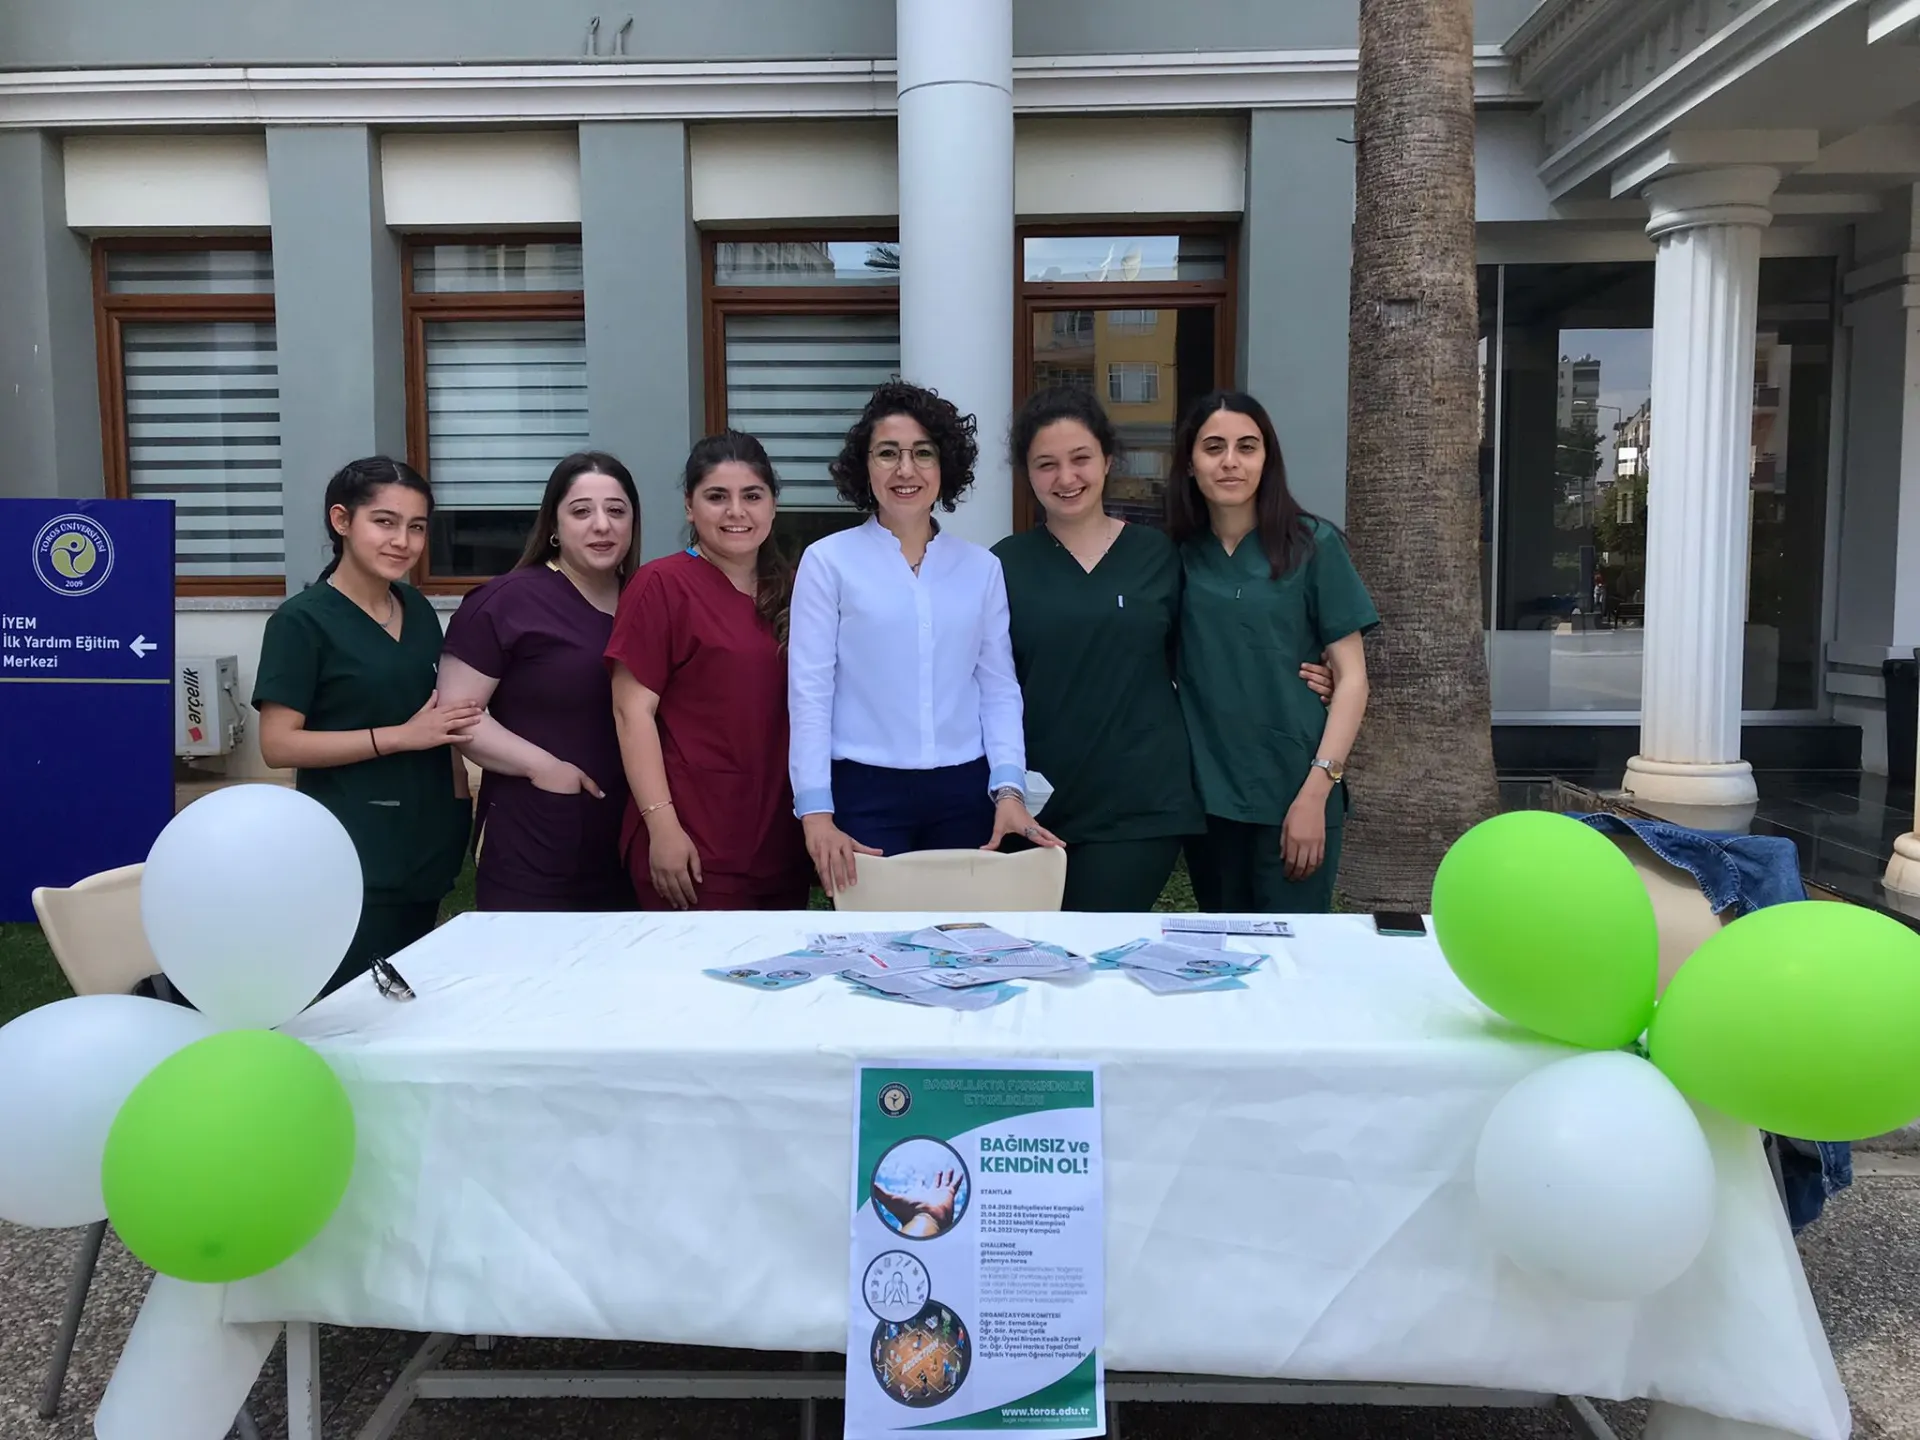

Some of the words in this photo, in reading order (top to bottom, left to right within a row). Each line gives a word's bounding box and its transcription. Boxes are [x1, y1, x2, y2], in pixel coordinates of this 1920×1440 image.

[40, 527, 60, 552] TOROS
[2, 614, 36, 629] İYEM
[3, 633, 20, 648] İlk
[24, 636, 72, 648] Yardım
[76, 636, 120, 652] Eğitim
[3, 655, 58, 668] Merkezi
[183, 668, 203, 725] arçelik
[980, 1134, 1065, 1153] BAĞIMSIZ
[1068, 1141, 1090, 1153] ve
[1057, 1158, 1089, 1174] OL!
[1001, 1406, 1090, 1416] www.toros.edu.tr
